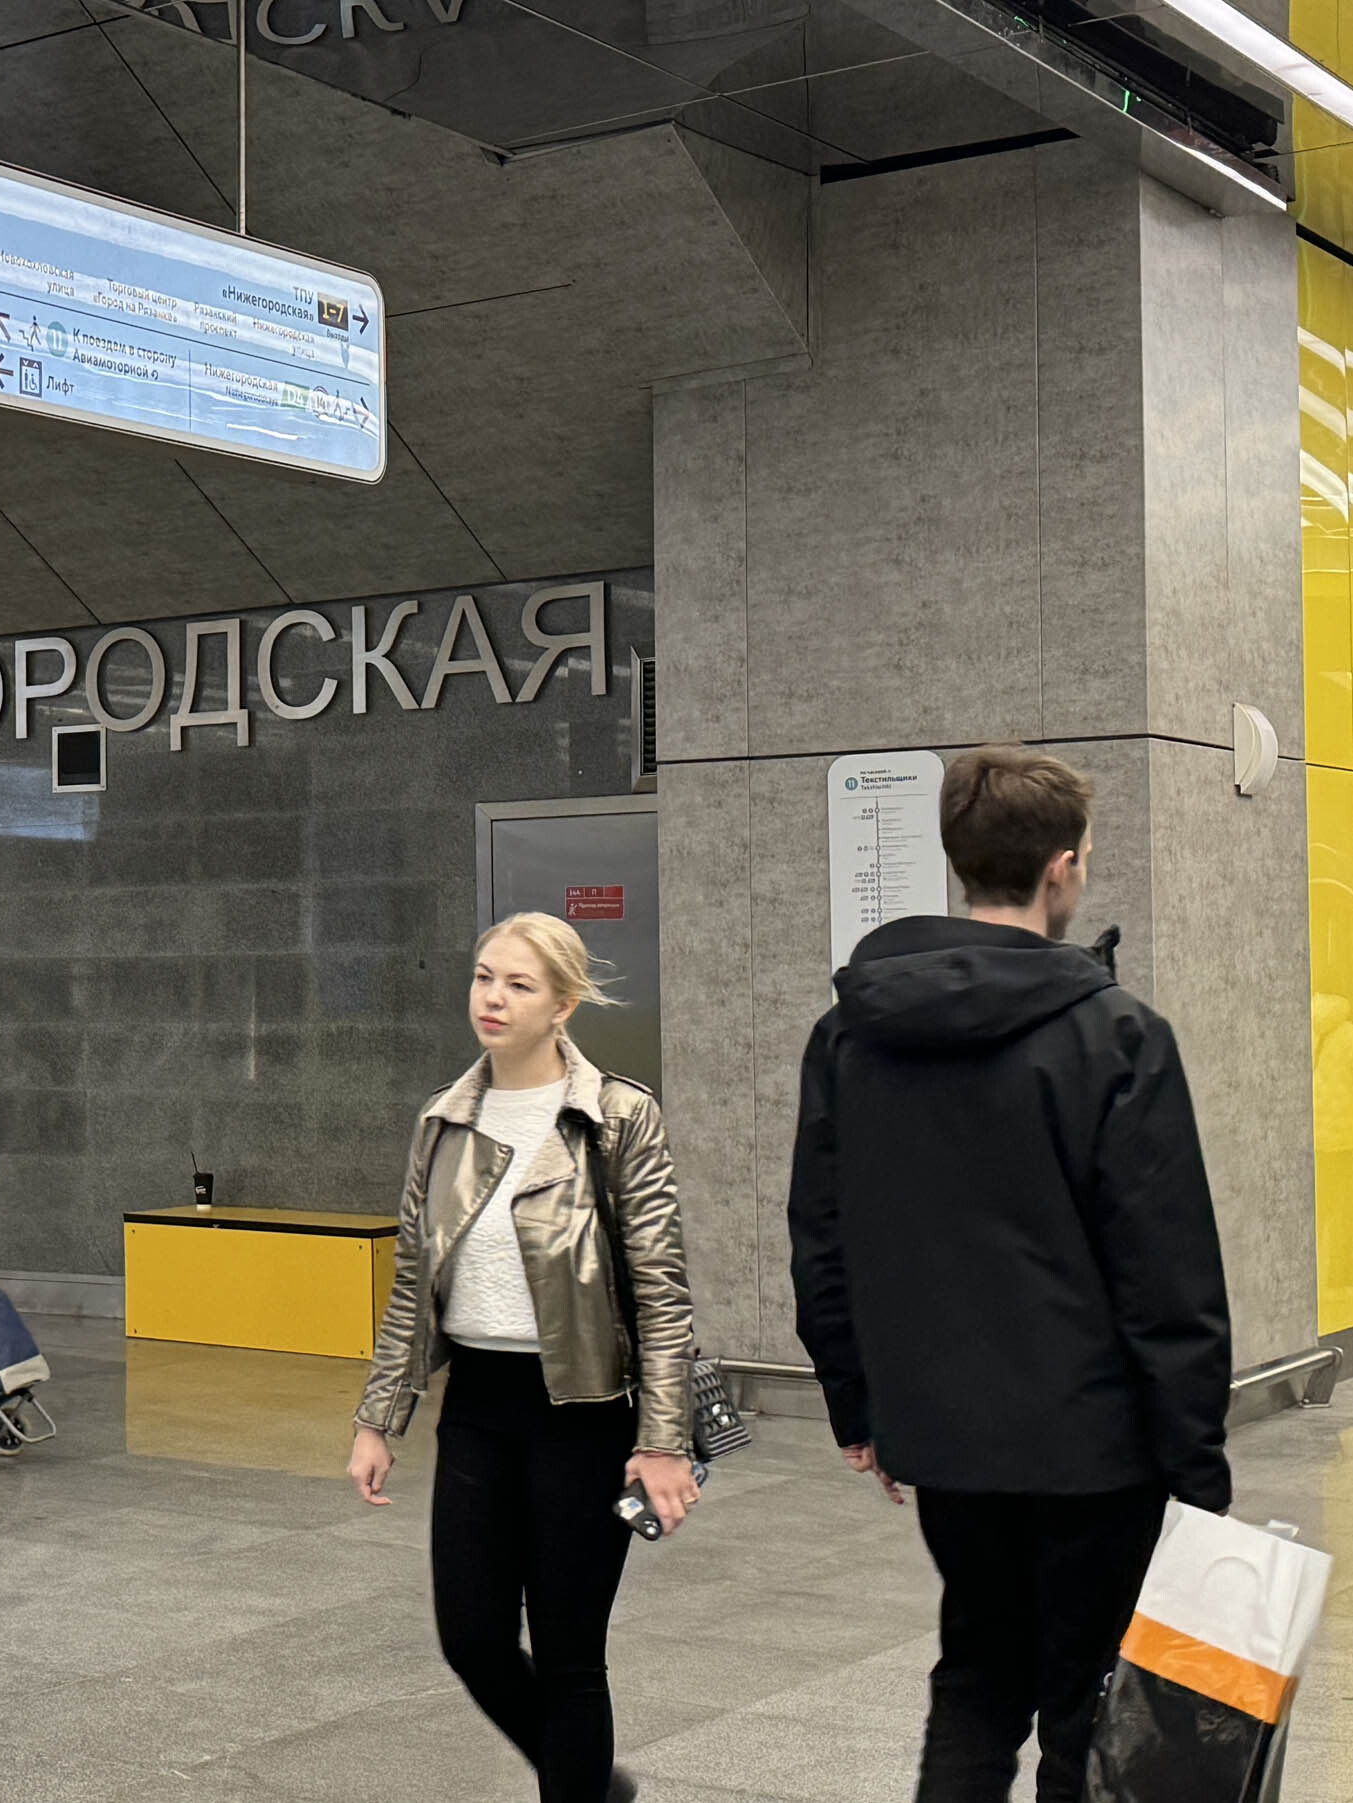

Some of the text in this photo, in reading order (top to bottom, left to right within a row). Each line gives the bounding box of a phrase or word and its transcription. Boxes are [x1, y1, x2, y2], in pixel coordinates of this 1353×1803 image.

[46, 281, 75, 298] улица
[106, 277, 178, 312] Торговый центр
[221, 284, 315, 323] «Нижегородская»
[292, 286, 315, 306] ТПУ
[72, 328, 177, 370] К поездам в сторону
[72, 349, 149, 380] Авиамоторной
[46, 375, 75, 397] Лифт
[204, 361, 279, 394] Нижегородская
